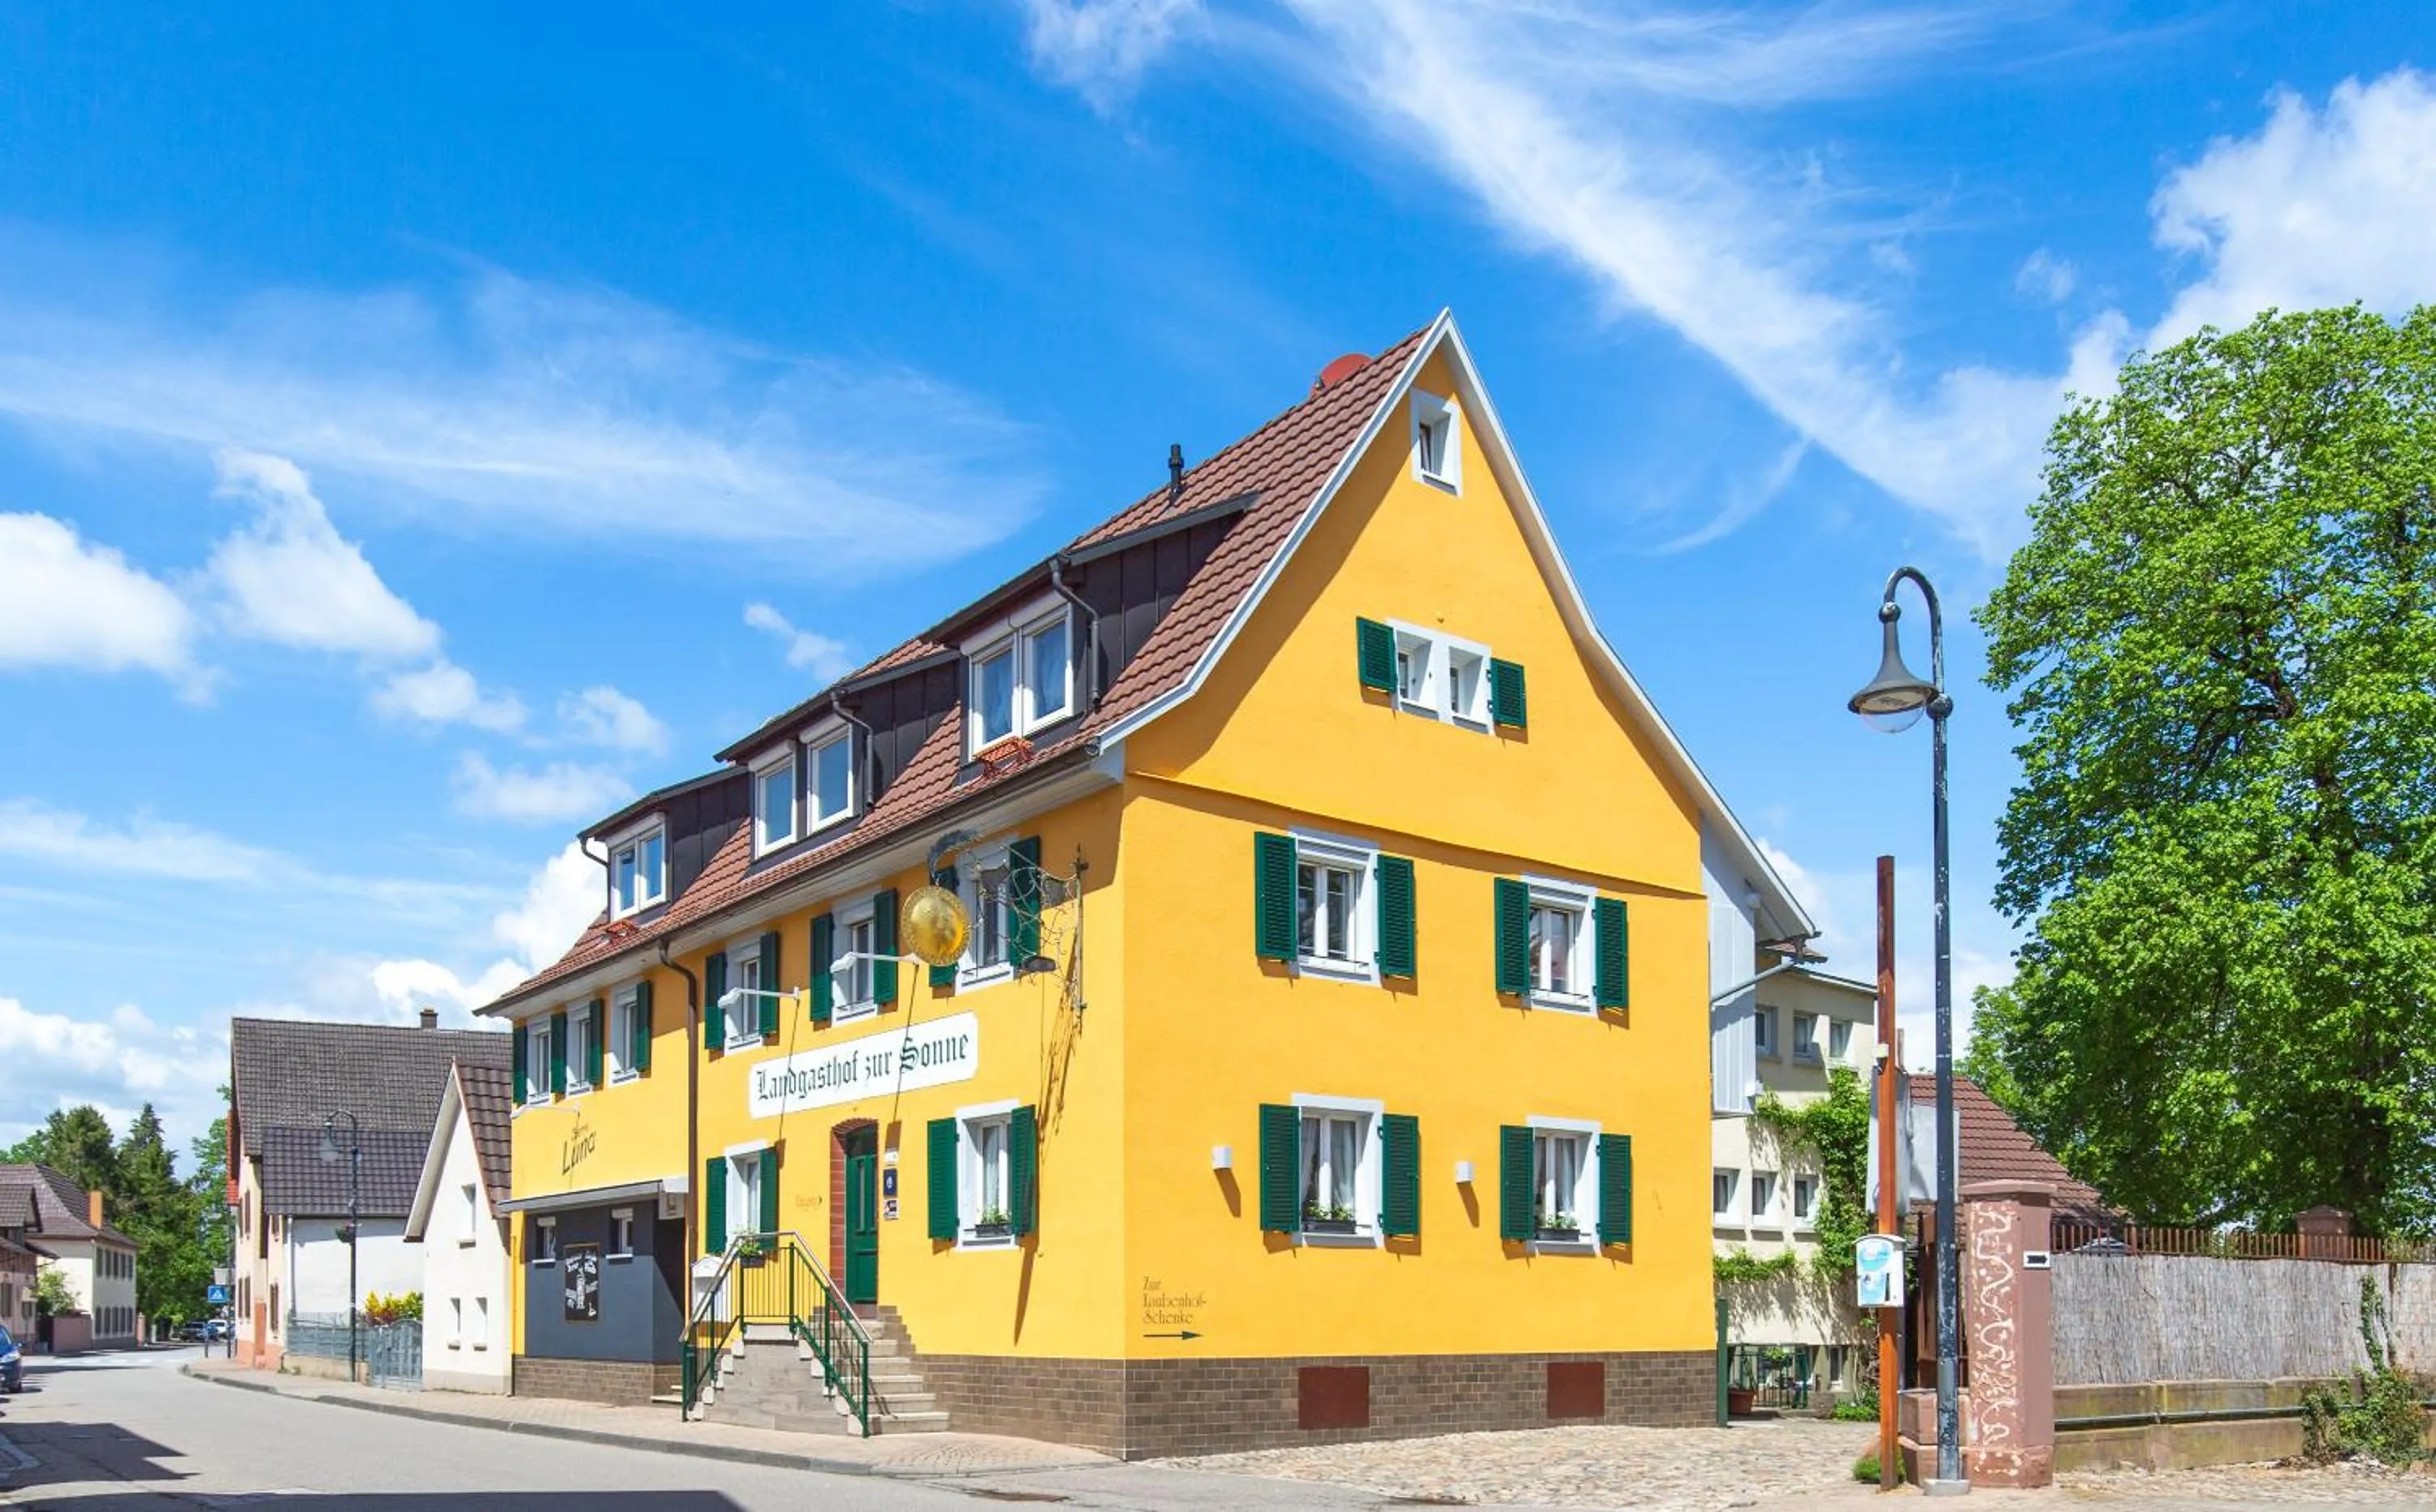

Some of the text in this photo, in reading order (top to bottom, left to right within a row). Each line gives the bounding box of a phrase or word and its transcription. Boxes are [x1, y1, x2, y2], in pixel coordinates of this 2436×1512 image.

[757, 1035, 969, 1100] Landgasthof zur Sonne
[562, 1130, 597, 1176] Luna
